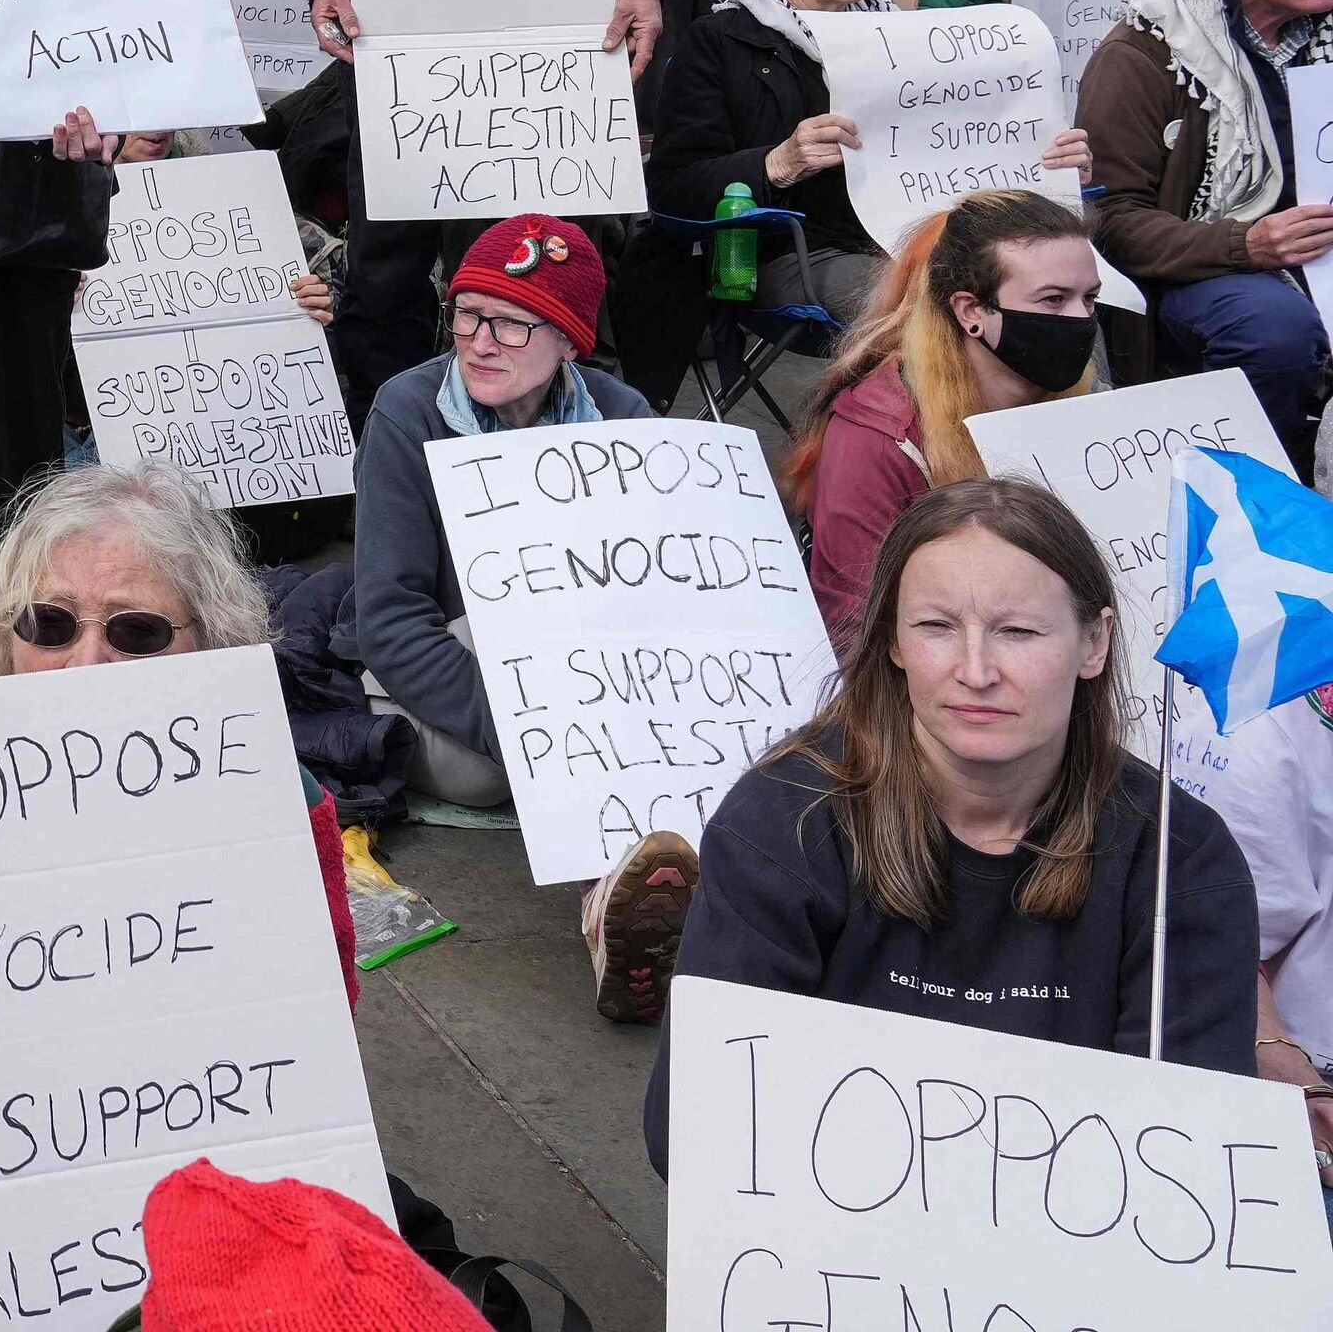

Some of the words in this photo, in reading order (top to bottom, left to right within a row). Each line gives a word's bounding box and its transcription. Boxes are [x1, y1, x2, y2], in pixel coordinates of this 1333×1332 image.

[27, 21, 173, 78] ACTION
[876, 26, 897, 70] I
[928, 23, 1027, 63] OPPOSE
[384, 52, 408, 109] I
[428, 49, 608, 102] SUPPORT
[898, 70, 1043, 109] GENOCIDE
[390, 97, 631, 160] PALESTINE
[890, 126, 900, 157] I
[930, 118, 1043, 150] SUPPORT
[142, 168, 161, 210] I
[431, 156, 618, 209] ACTION
[900, 162, 1042, 203] PALESTINE
[107, 206, 262, 265] PPOSE
[82, 260, 300, 325] GENOCIDE
[182, 328, 199, 362] I
[96, 346, 325, 417] SUPPORT
[133, 410, 352, 467] PALESTINE
[451, 455, 519, 518] I
[534, 439, 765, 503] OPPOSE
[1032, 453, 1057, 495] I
[466, 533, 798, 602] GENOCIDE
[502, 655, 548, 717] I
[567, 648, 792, 708] SUPPORT
[889, 970, 920, 989] tell
[922, 981, 956, 997] your
[964, 988, 993, 1004] dog
[999, 988, 1006, 1000] i
[1011, 985, 1049, 998] said
[1054, 986, 1071, 999] hi
[0, 1059, 296, 1176] SUPPORT
[725, 1035, 775, 1197] I
[812, 1067, 1296, 1273] OPPOSE
